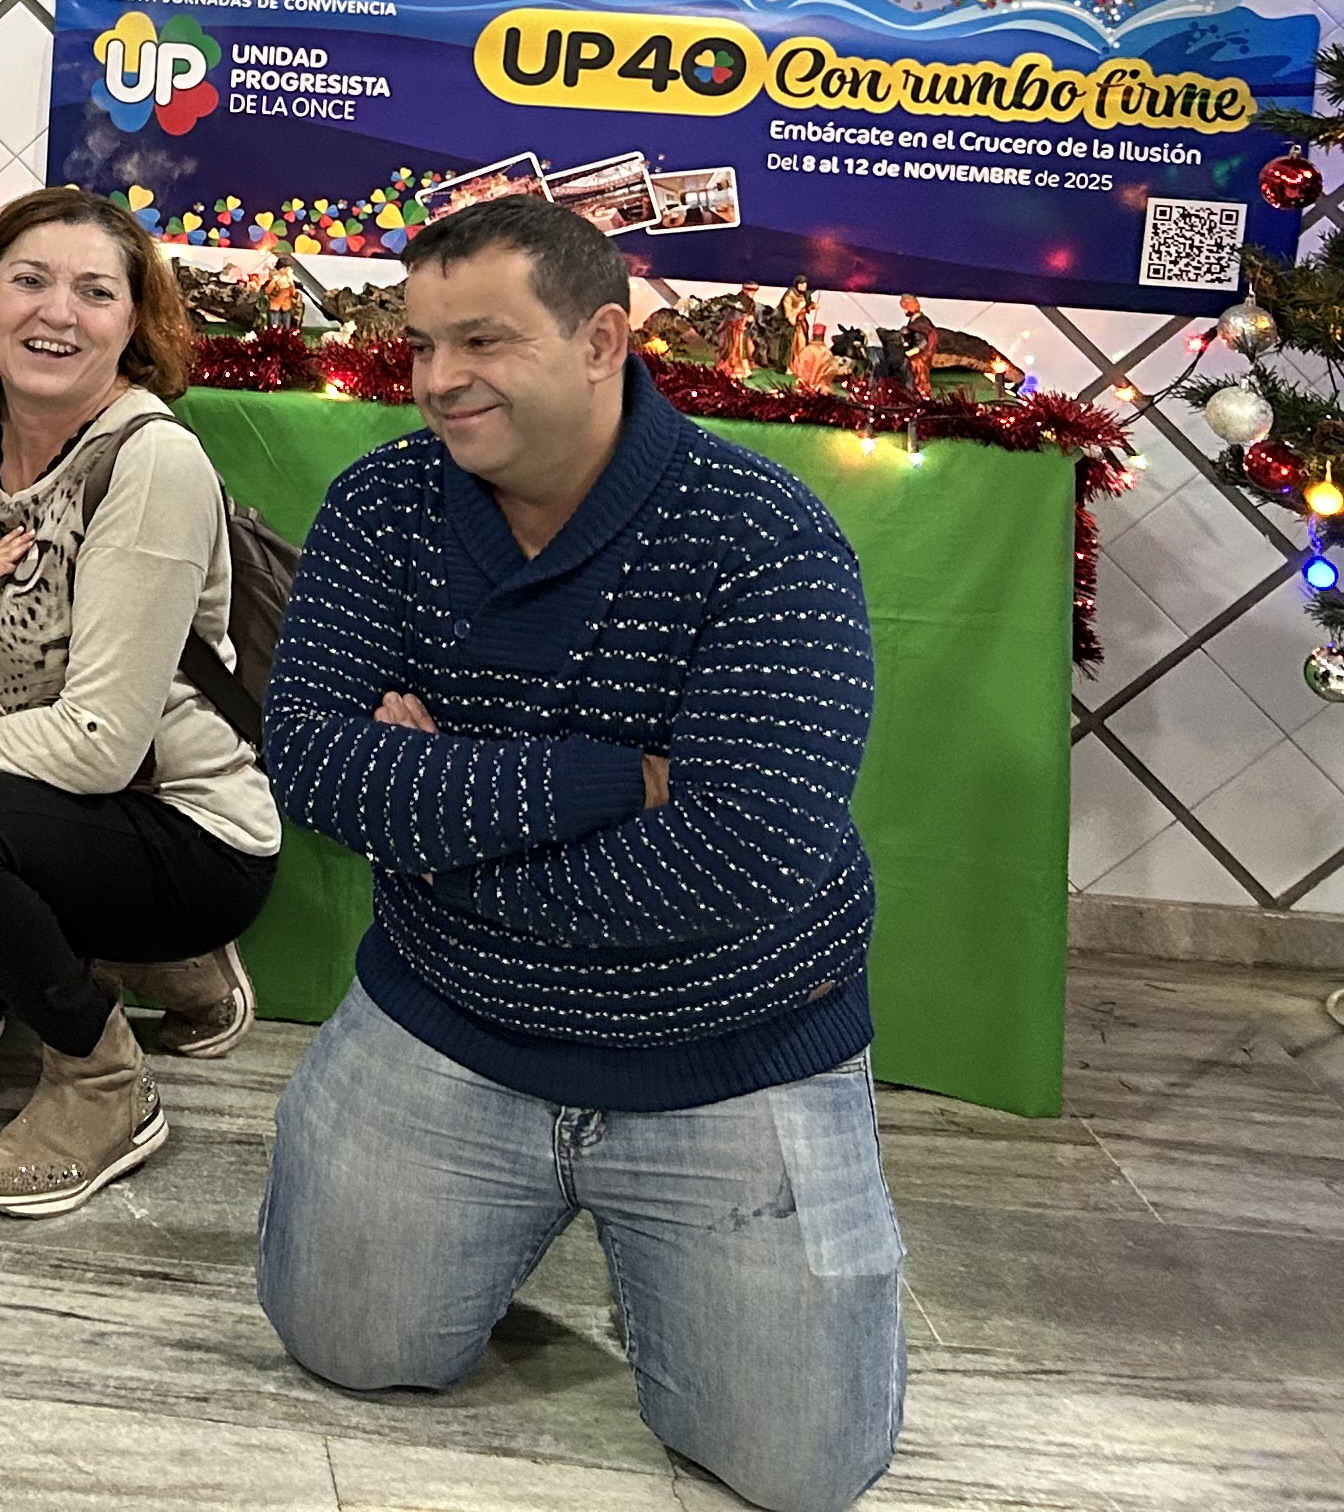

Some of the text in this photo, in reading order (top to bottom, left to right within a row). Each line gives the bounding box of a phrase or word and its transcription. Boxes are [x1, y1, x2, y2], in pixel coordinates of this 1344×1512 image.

[105, 39, 207, 106] UP
[232, 44, 328, 68] UNIDAD
[230, 69, 391, 98] PROGRESISTA
[775, 47, 1246, 124] Con rumbo firme
[229, 93, 356, 121] DE LA ONCE
[770, 119, 1202, 165] Embárcate en el Crucero de la Ilusión
[767, 152, 1113, 191] Del 8 al 12 de NOVIEMBRE de 2025
